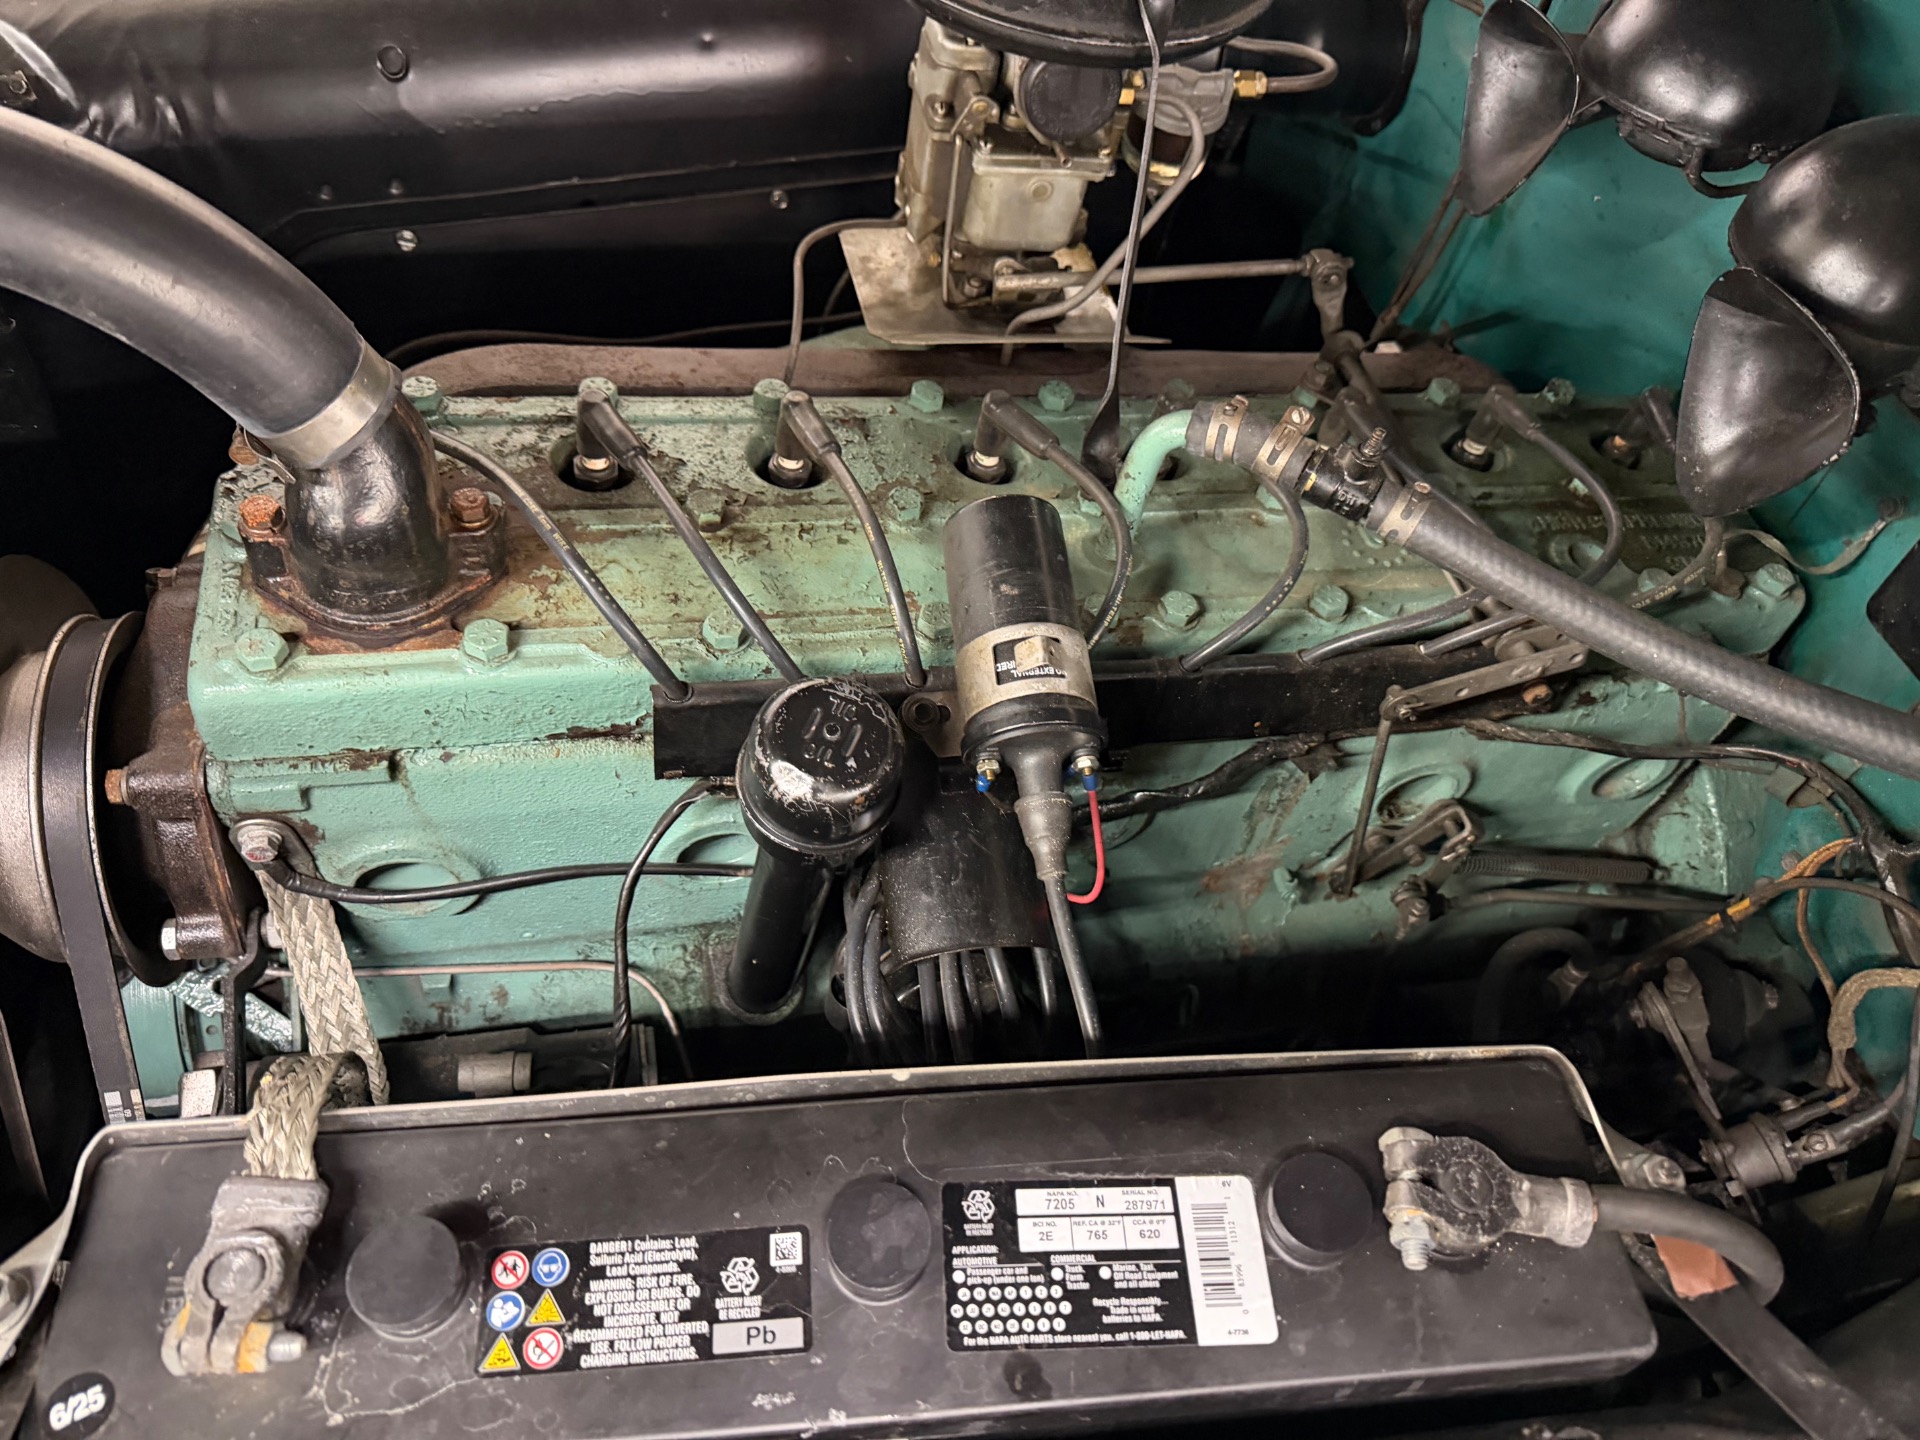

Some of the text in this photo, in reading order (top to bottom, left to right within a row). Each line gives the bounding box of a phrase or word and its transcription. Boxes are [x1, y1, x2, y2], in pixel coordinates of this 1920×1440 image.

[553, 533, 570, 551] WIRE
[804, 743, 836, 768] OIL
[1222, 1180, 1232, 1188] 6V
[1044, 1195, 1166, 1211] 7205 N 287971
[1039, 1229, 1161, 1242] 2E 765 620
[634, 1238, 674, 1251] Contains:
[952, 1245, 999, 1254] APPLICATION:
[589, 1252, 623, 1267] Sulfuric
[624, 1250, 643, 1264] Acid
[952, 1256, 998, 1266] AUTOMOTIVE
[1050, 1254, 1096, 1263] COMMERCIAL
[606, 1265, 628, 1277] Lead
[967, 1267, 1002, 1277] Passenger
[1014, 1266, 1028, 1274] and
[1126, 1271, 1142, 1280] Road
[1143, 1270, 1179, 1280] Equipment
[589, 1278, 635, 1292] WARNING:
[636, 1276, 658, 1289] RISK
[659, 1275, 673, 1287] OF
[967, 1276, 992, 1286] pick-up
[993, 1275, 1015, 1285] (under
[1030, 1274, 1045, 1284] ton)
[1066, 1281, 1090, 1290] Tractor
[1114, 1280, 1160, 1289] and all others
[584, 1289, 635, 1306] EXPLOSION
[636, 1288, 650, 1301] OR
[686, 1284, 701, 1298] DO
[593, 1297, 691, 1317] NOT DISASSEMBLE OR
[715, 1295, 762, 1309] BATTERY MUST
[1092, 1297, 1120, 1308] Recycle
[719, 1306, 761, 1320] BE RECYCLED
[1138, 1305, 1155, 1313] used
[660, 1310, 680, 1323] NOT
[1102, 1314, 1133, 1324] batteries
[1133, 1314, 1141, 1322] to
[573, 1320, 709, 1343] RECOMMENDED FOR INVERTED
[746, 1325, 776, 1345] Pb
[1227, 1328, 1250, 1336] 4-7736
[613, 1338, 652, 1352] FOLLOW
[653, 1335, 691, 1349] PROPER
[963, 1336, 976, 1346] For
[976, 1336, 989, 1346] the
[989, 1335, 1009, 1345] NAPA
[1010, 1335, 1029, 1344] AUTO
[1030, 1334, 1053, 1343] PARTS
[1054, 1334, 1072, 1343] store
[1072, 1333, 1099, 1342] nearest
[1115, 1331, 1129, 1341] call
[580, 1346, 699, 1369] CHARGING INSTRUCTIONS.
[49, 1384, 106, 1431] 6/25
